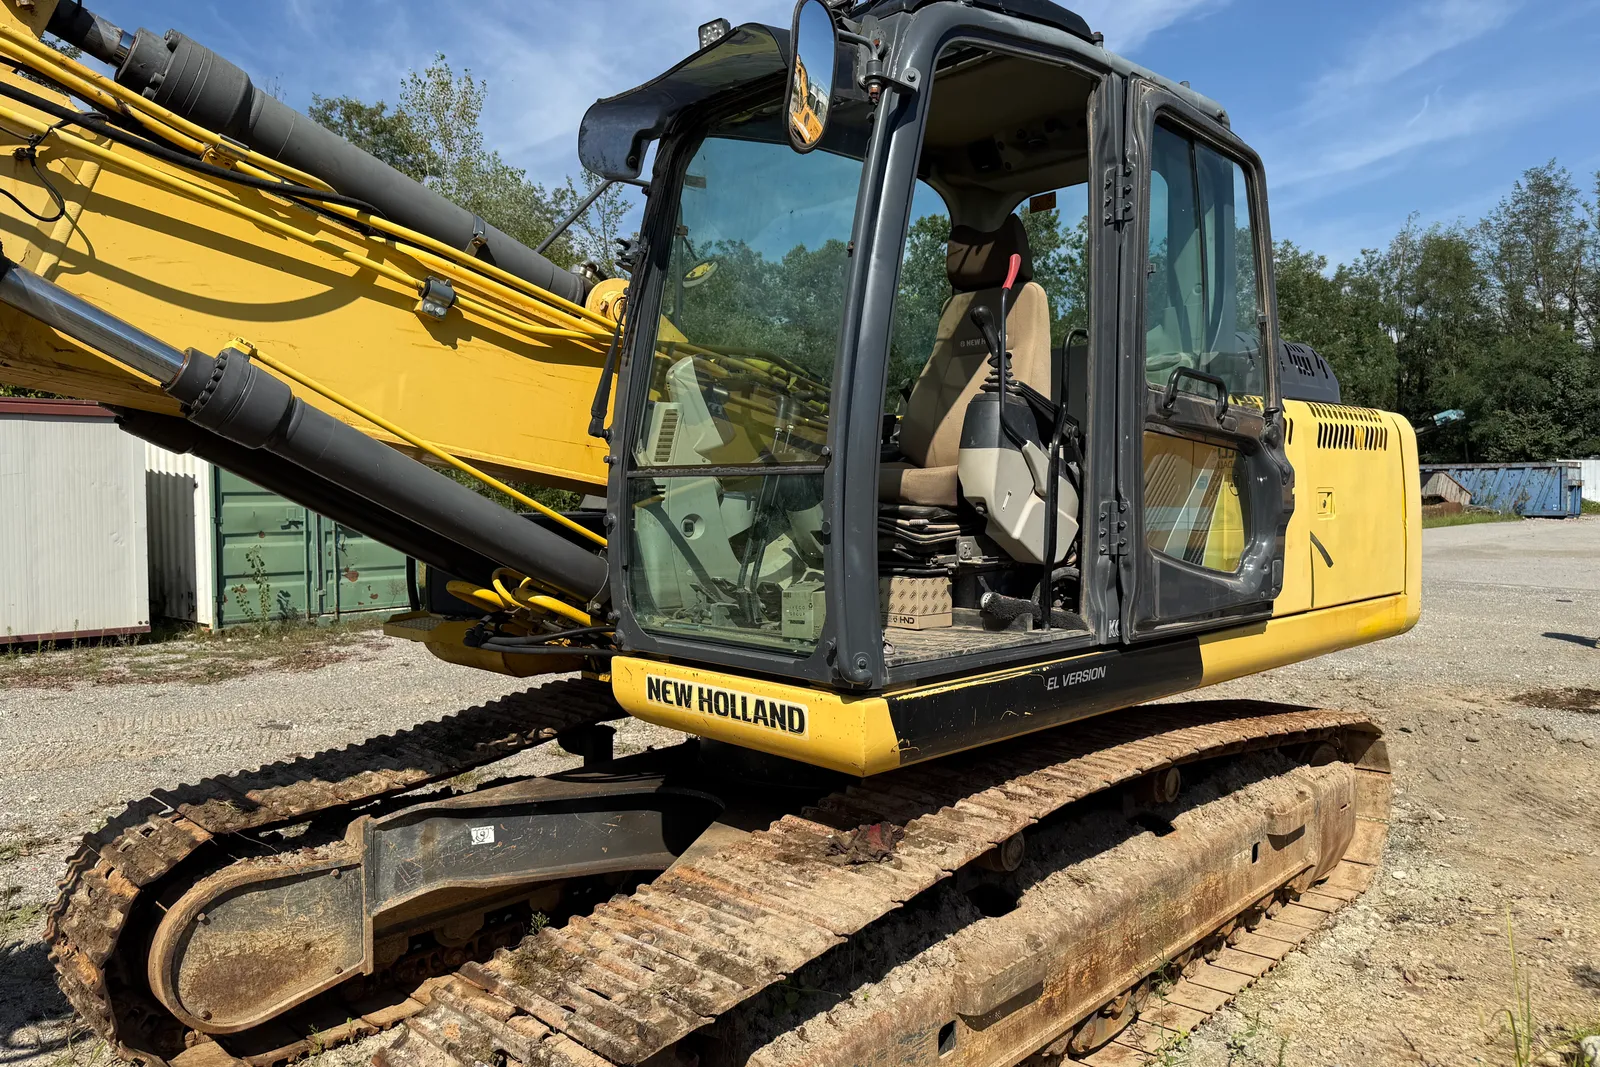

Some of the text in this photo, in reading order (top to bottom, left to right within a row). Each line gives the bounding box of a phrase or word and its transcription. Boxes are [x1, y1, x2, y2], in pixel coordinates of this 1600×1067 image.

[1047, 665, 1107, 691] EL VERSION
[647, 676, 806, 735] NEW HOLLAND
